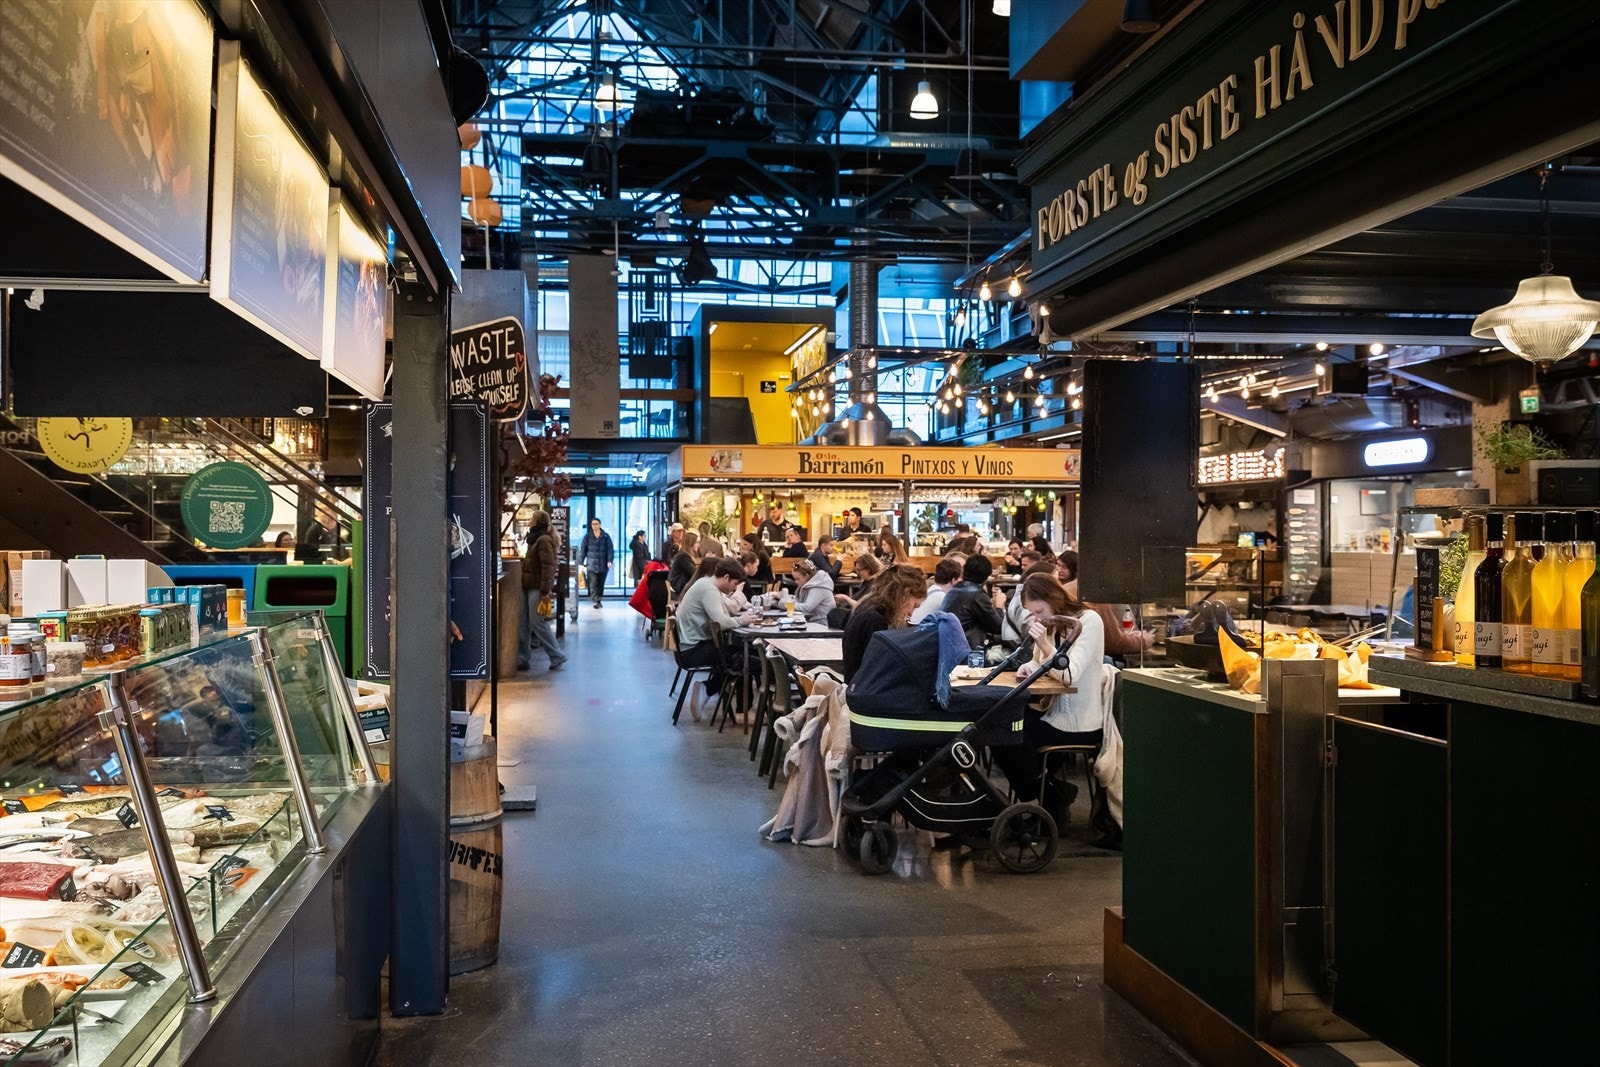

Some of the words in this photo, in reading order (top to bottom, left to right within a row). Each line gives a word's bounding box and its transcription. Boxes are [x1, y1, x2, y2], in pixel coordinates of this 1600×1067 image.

[1038, 163, 1118, 250] FØRSTE
[1124, 150, 1150, 206] og
[1155, 74, 1240, 178] SISTE
[1254, 0, 1385, 119] HÅND
[1395, 0, 1447, 50] p
[451, 326, 516, 369] WASTE
[478, 368, 503, 388] CLEAN
[506, 366, 518, 383] UP
[798, 451, 884, 475] Barramón
